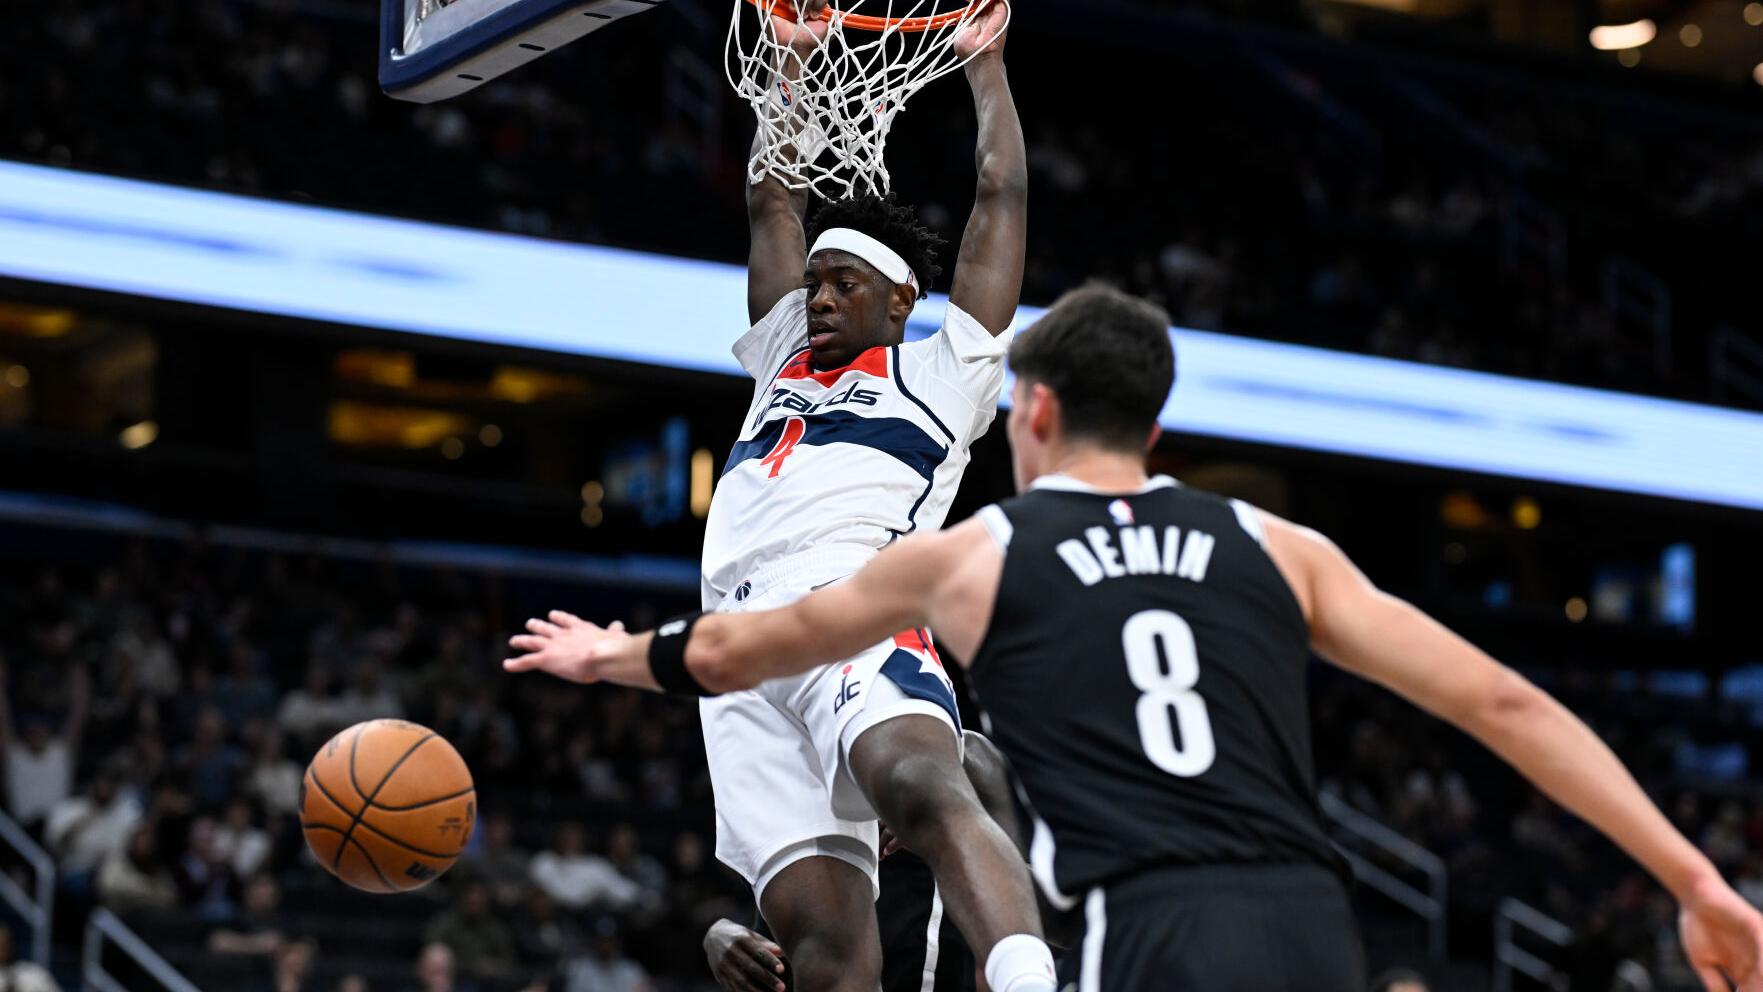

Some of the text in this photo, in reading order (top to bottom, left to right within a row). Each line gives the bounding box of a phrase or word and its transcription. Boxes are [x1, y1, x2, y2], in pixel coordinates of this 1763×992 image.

[751, 381, 883, 430] zards
[760, 417, 806, 478] 4
[1056, 525, 1215, 586] DEMIN
[833, 664, 860, 714] dc
[1122, 609, 1216, 777] 8
